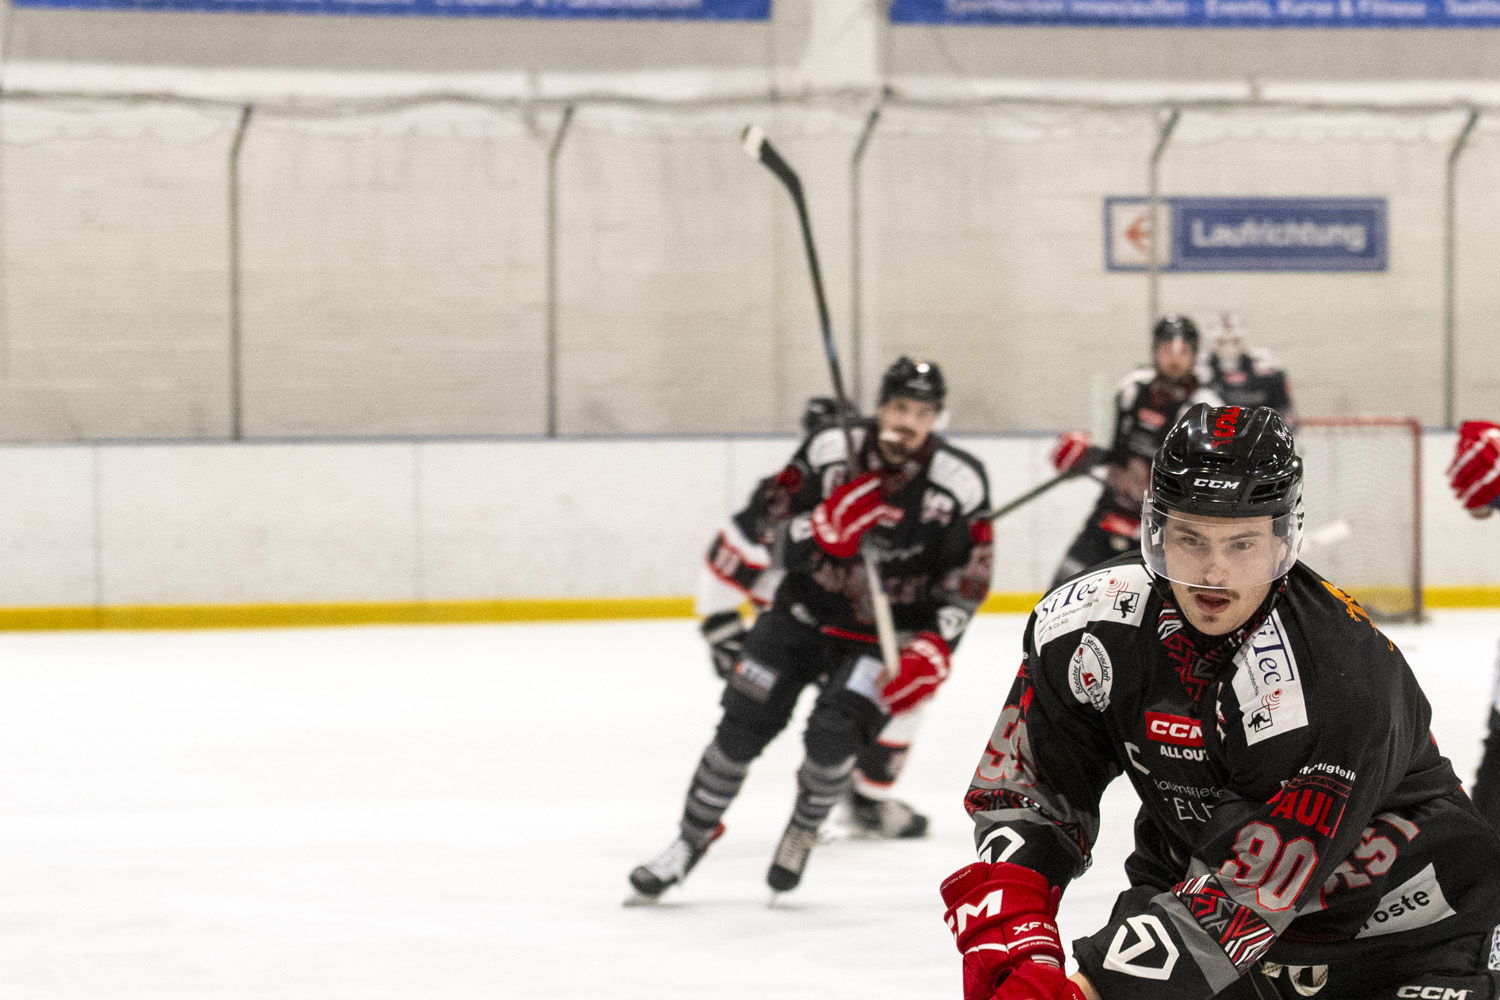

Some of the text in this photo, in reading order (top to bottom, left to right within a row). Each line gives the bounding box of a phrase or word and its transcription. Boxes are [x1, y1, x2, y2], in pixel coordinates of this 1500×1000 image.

[1191, 217, 1368, 252] Laufrichtung
[1193, 477, 1240, 490] CCM
[1160, 745, 1182, 759] ALL
[1220, 820, 1320, 912] 90
[1012, 921, 1058, 936] XF 80
